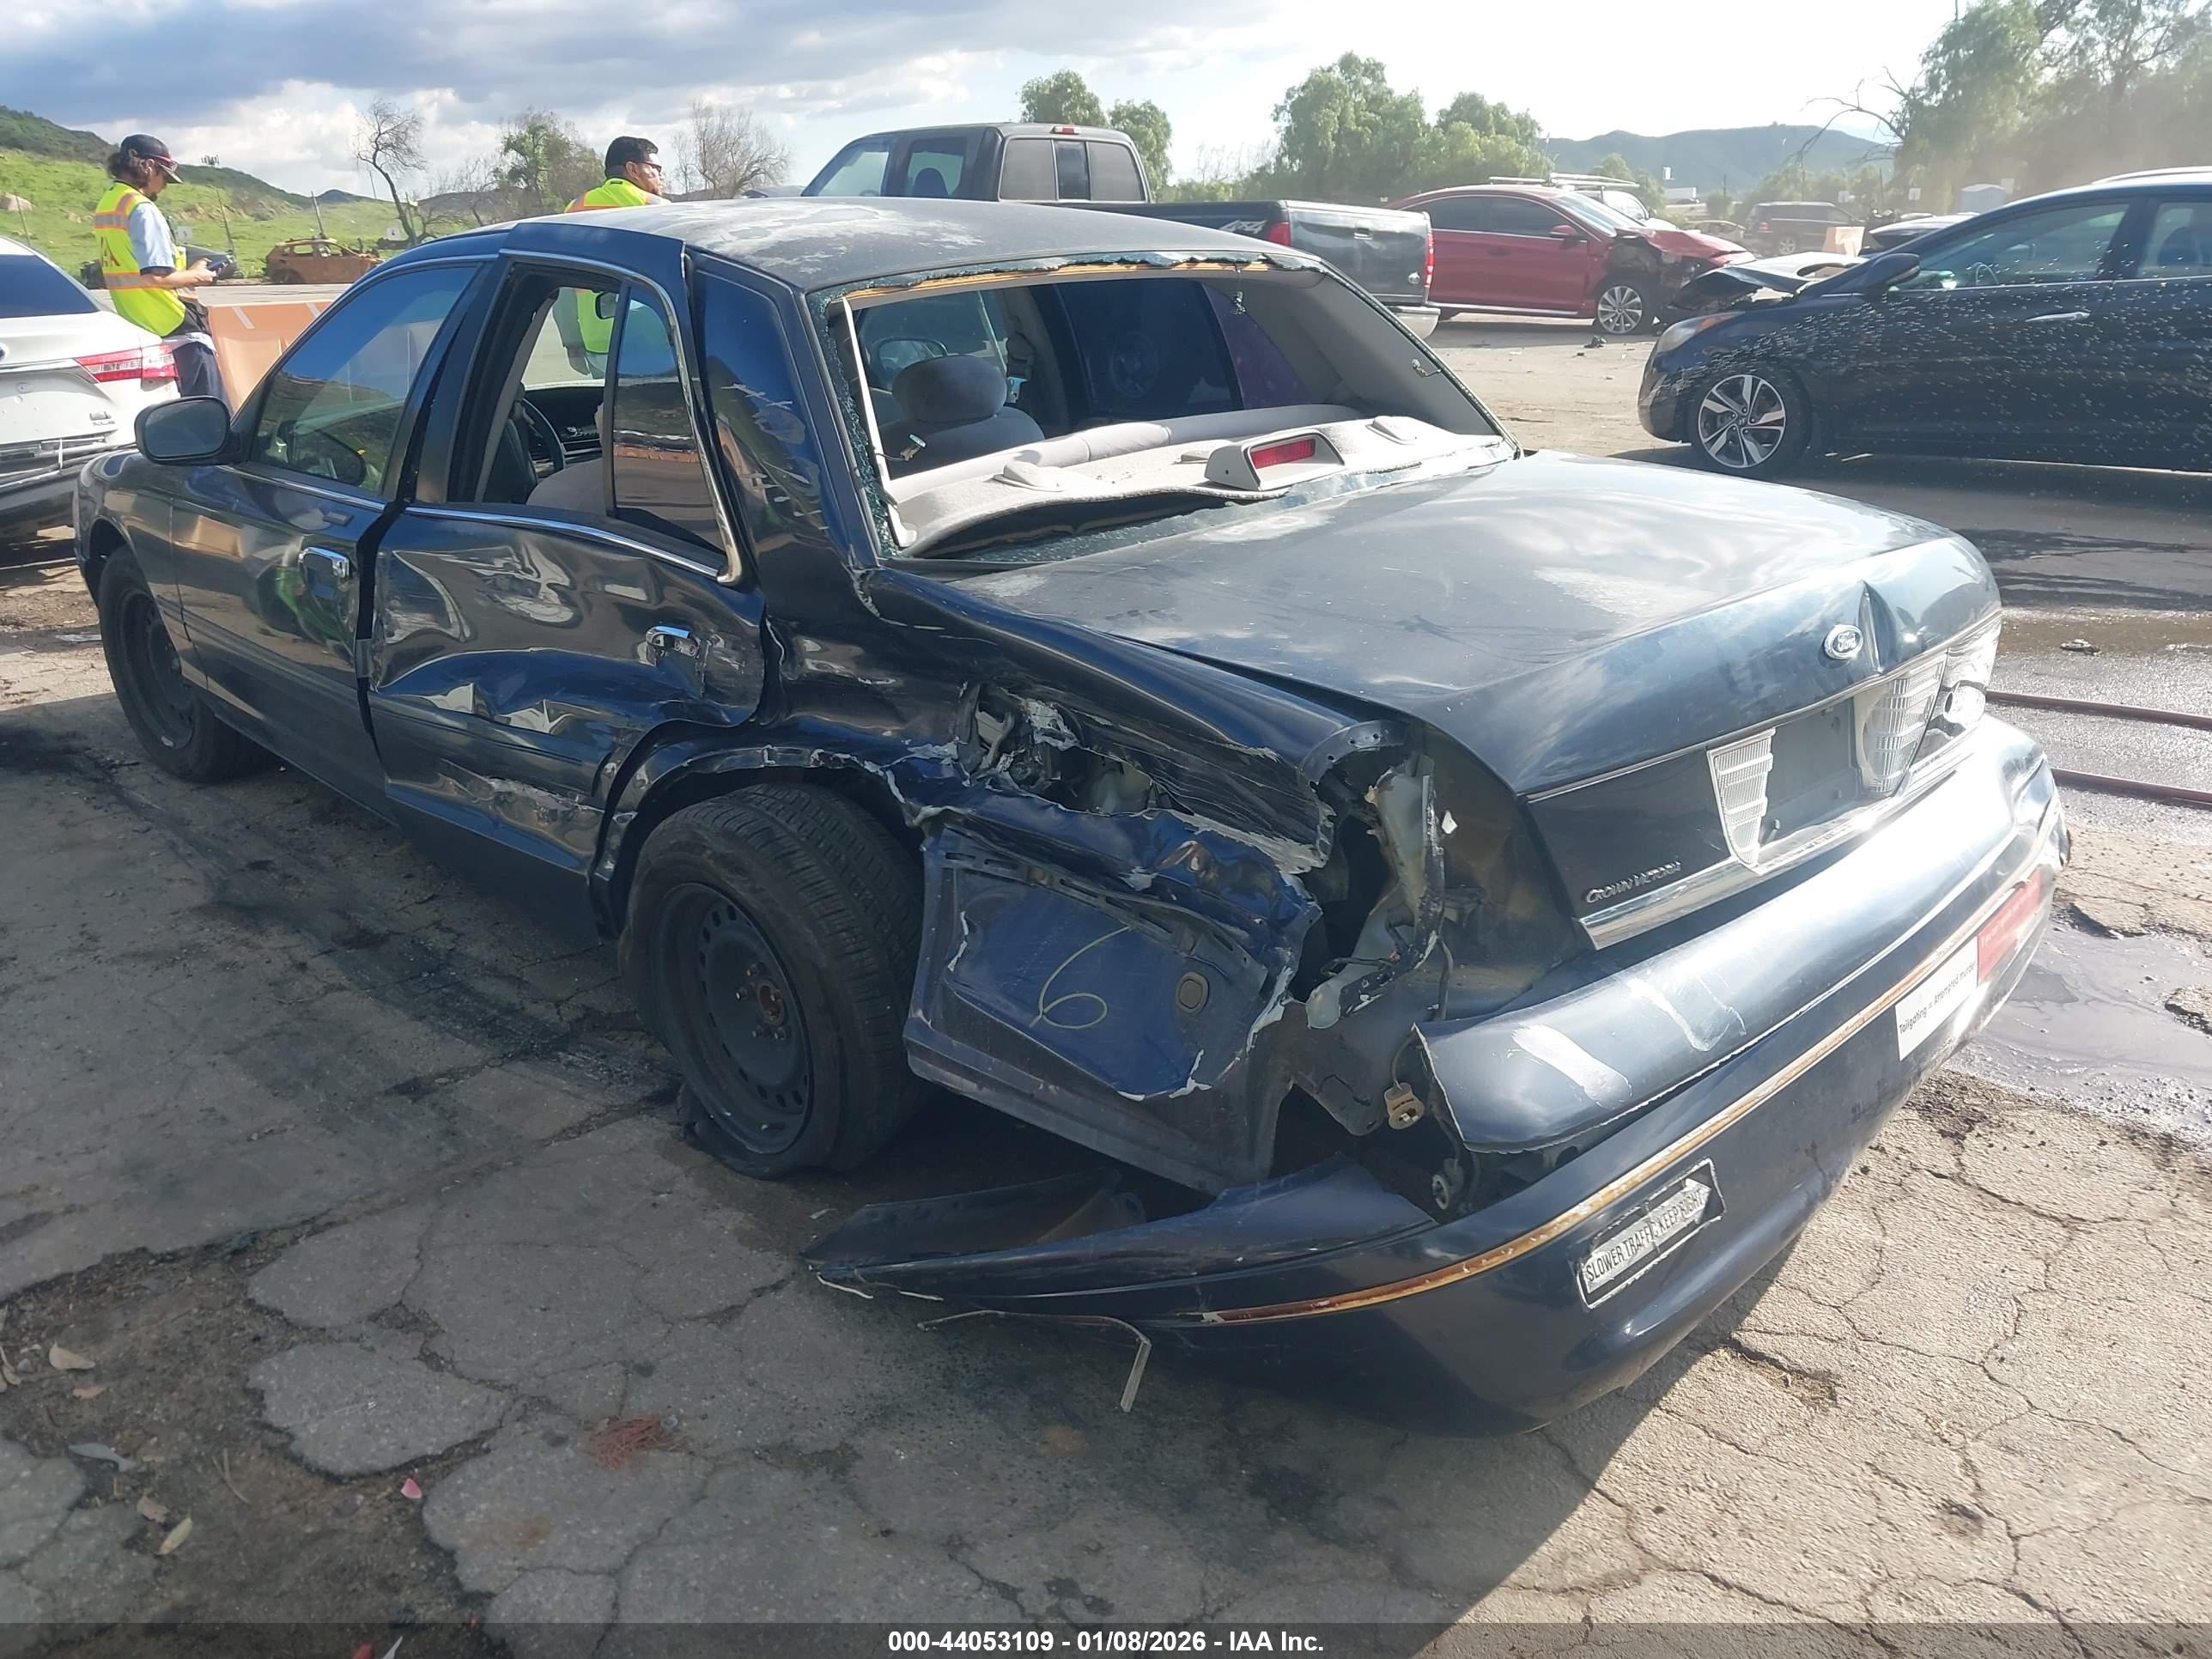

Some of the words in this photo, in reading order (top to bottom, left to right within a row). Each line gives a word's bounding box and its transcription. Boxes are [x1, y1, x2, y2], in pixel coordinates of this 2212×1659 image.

[1586, 878, 1632, 903] CROWN
[1633, 861, 1681, 887] VICTORIA
[1029, 925, 1132, 1030] 6
[1899, 1007, 1927, 1035] Tailgating
[1934, 973, 1959, 1006] Attempted
[1586, 1245, 1626, 1282] SLOWER
[1622, 1220, 1660, 1258] TRAFFIC
[1656, 1206, 1680, 1235] KEEP
[1676, 1188, 1703, 1218] RIGHT
